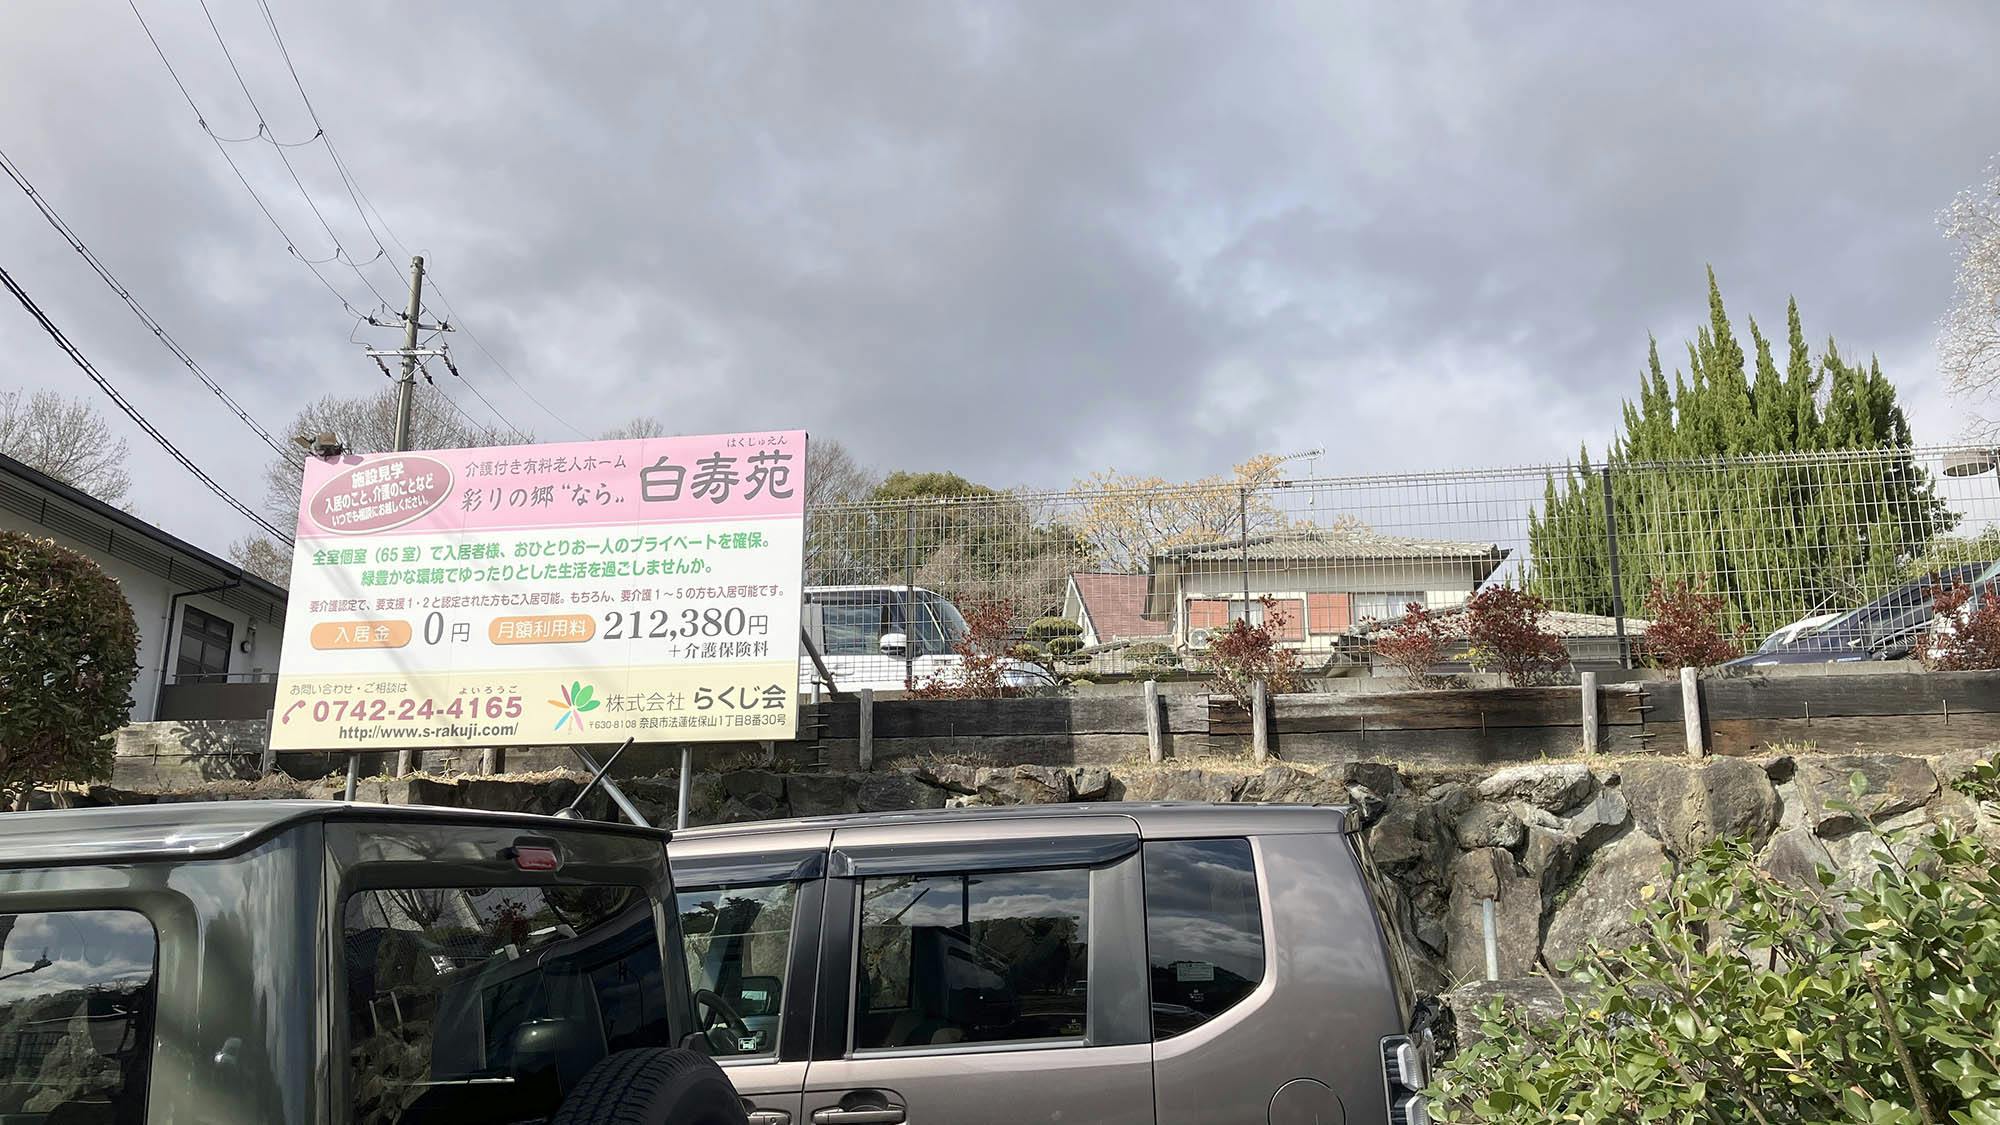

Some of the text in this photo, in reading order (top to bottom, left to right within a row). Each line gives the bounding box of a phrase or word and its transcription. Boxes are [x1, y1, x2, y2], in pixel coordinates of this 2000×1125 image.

[727, 435, 787, 448] はくじゅえん
[351, 462, 404, 488] 施設見学
[465, 455, 627, 477] 介護付き有料老人ホーム
[640, 449, 794, 504] 白寿苑
[325, 473, 434, 514] 入居のこと、介護のことなど
[361, 558, 712, 586] 緑豊かな環境でゆったりとした生活を過ごしませんか。
[334, 625, 390, 643] 入居金
[424, 611, 470, 645] 0円
[498, 619, 586, 639] 月額利用料
[603, 607, 768, 641] 212,380円
[290, 683, 408, 696] お問い合わせ・ご相談は
[459, 686, 518, 695] よいろうご
[606, 684, 786, 713] 株式会社 らくじ会
[313, 696, 522, 722] 0742-24-4165
[339, 722, 519, 740] http://www.s-rakuji.com/
